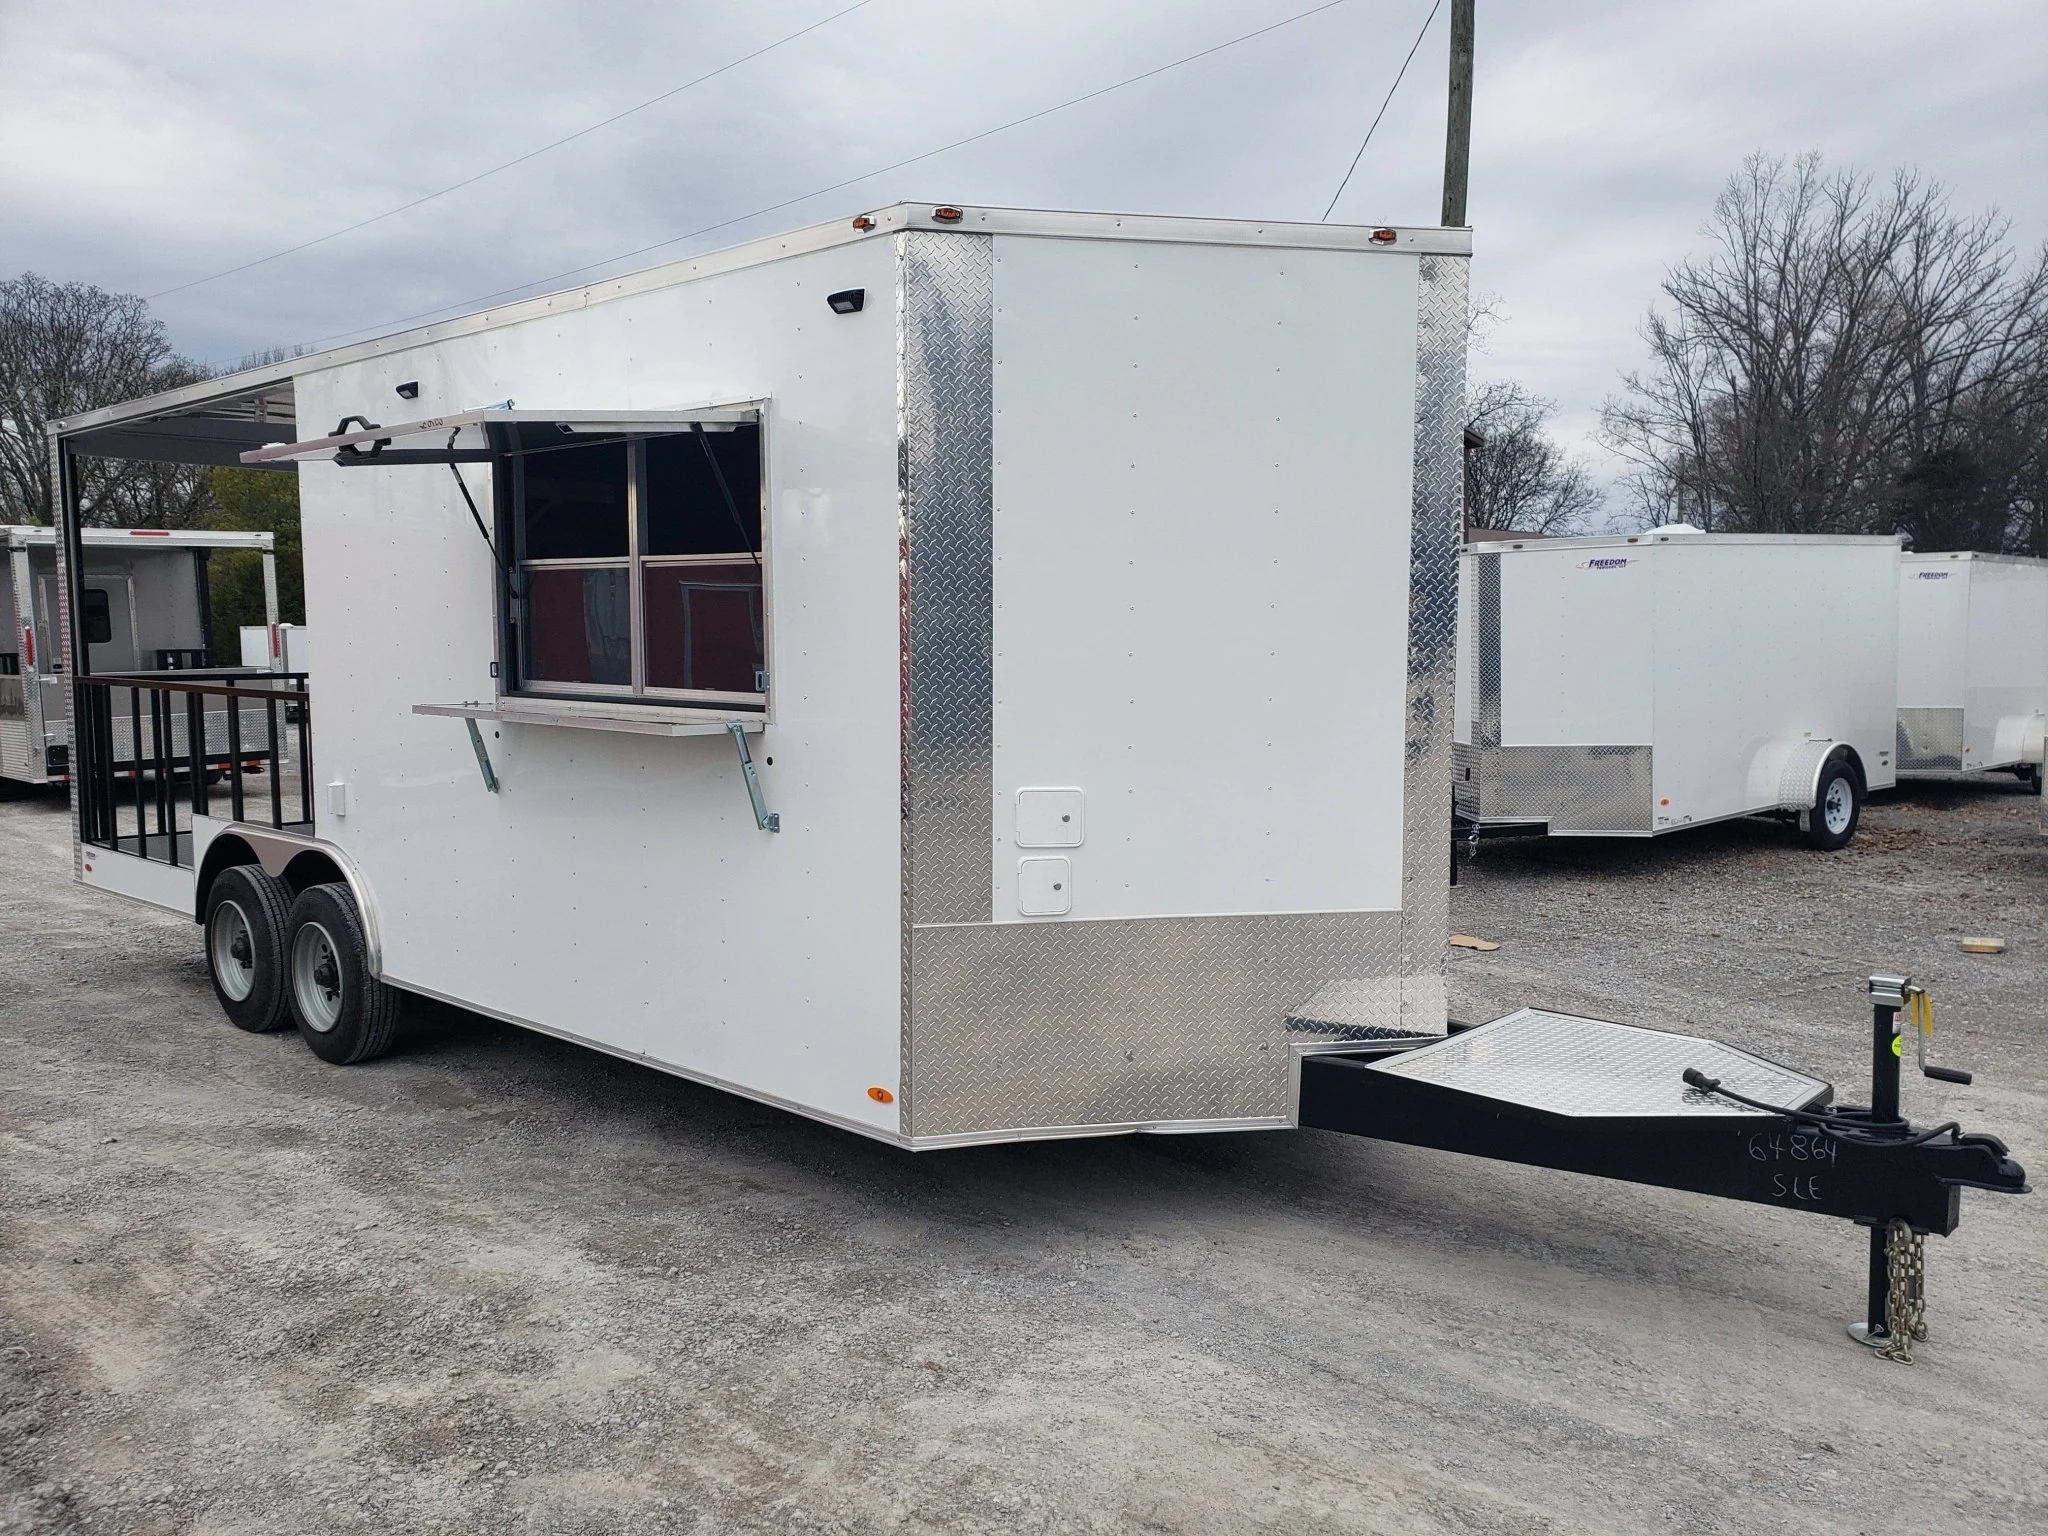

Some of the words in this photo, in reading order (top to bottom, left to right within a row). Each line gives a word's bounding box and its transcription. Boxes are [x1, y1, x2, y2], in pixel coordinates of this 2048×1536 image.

[1588, 558, 1627, 568] FREEDOM
[1748, 1132, 1838, 1168] 64864
[1771, 1173, 1823, 1200] SLE
